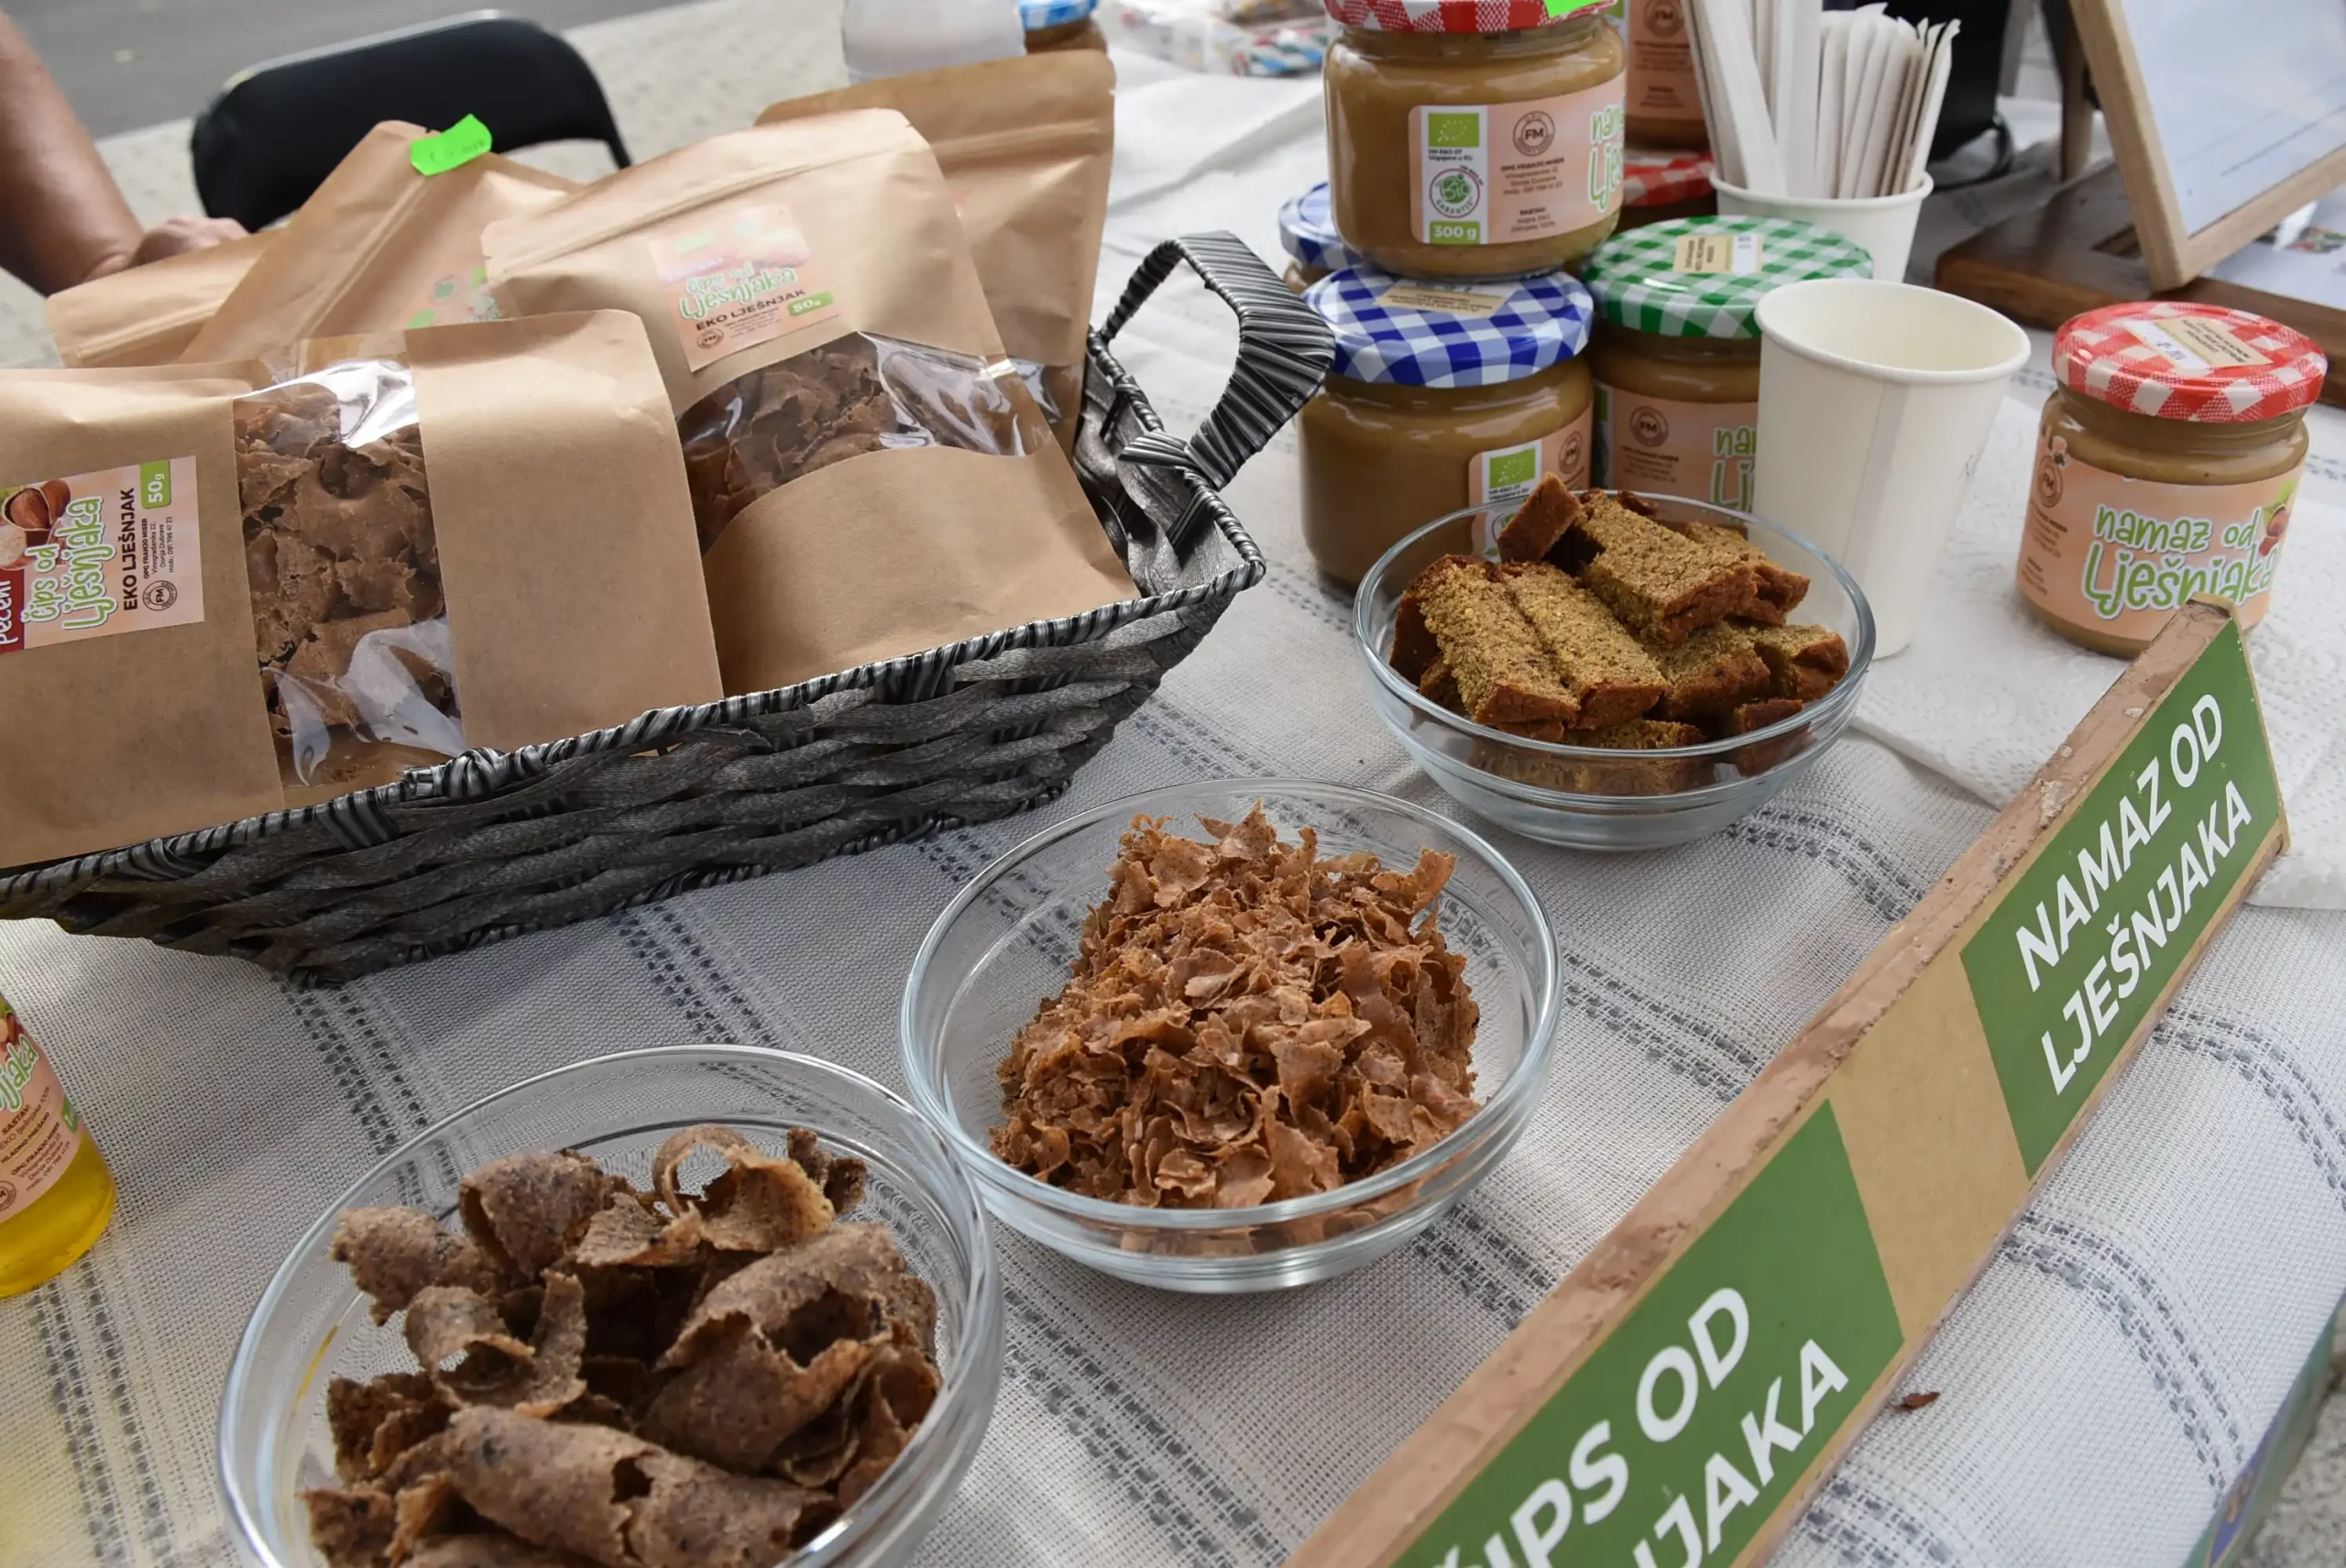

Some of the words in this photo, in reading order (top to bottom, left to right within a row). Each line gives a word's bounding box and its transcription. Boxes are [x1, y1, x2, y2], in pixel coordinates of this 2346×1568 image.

[1525, 127, 1544, 140] FM
[1434, 225, 1464, 238] 300
[1467, 227, 1478, 241] g
[696, 313, 728, 331] EKO
[730, 288, 806, 318] LJEŠNJAK
[1715, 426, 1757, 456] na
[118, 488, 137, 570] LJEŠNJAK
[2095, 505, 2212, 553] namaz
[2222, 507, 2262, 550] od
[25, 543, 60, 572] od
[56, 496, 118, 629] Lješnjaka
[124, 577, 138, 610] EKO
[156, 588, 165, 604] FM
[2015, 756, 2172, 992] NAMAZ
[2169, 694, 2223, 788] OD
[2041, 781, 2253, 1095] LJEŠNJAKA
[1635, 1288, 1749, 1442] OD
